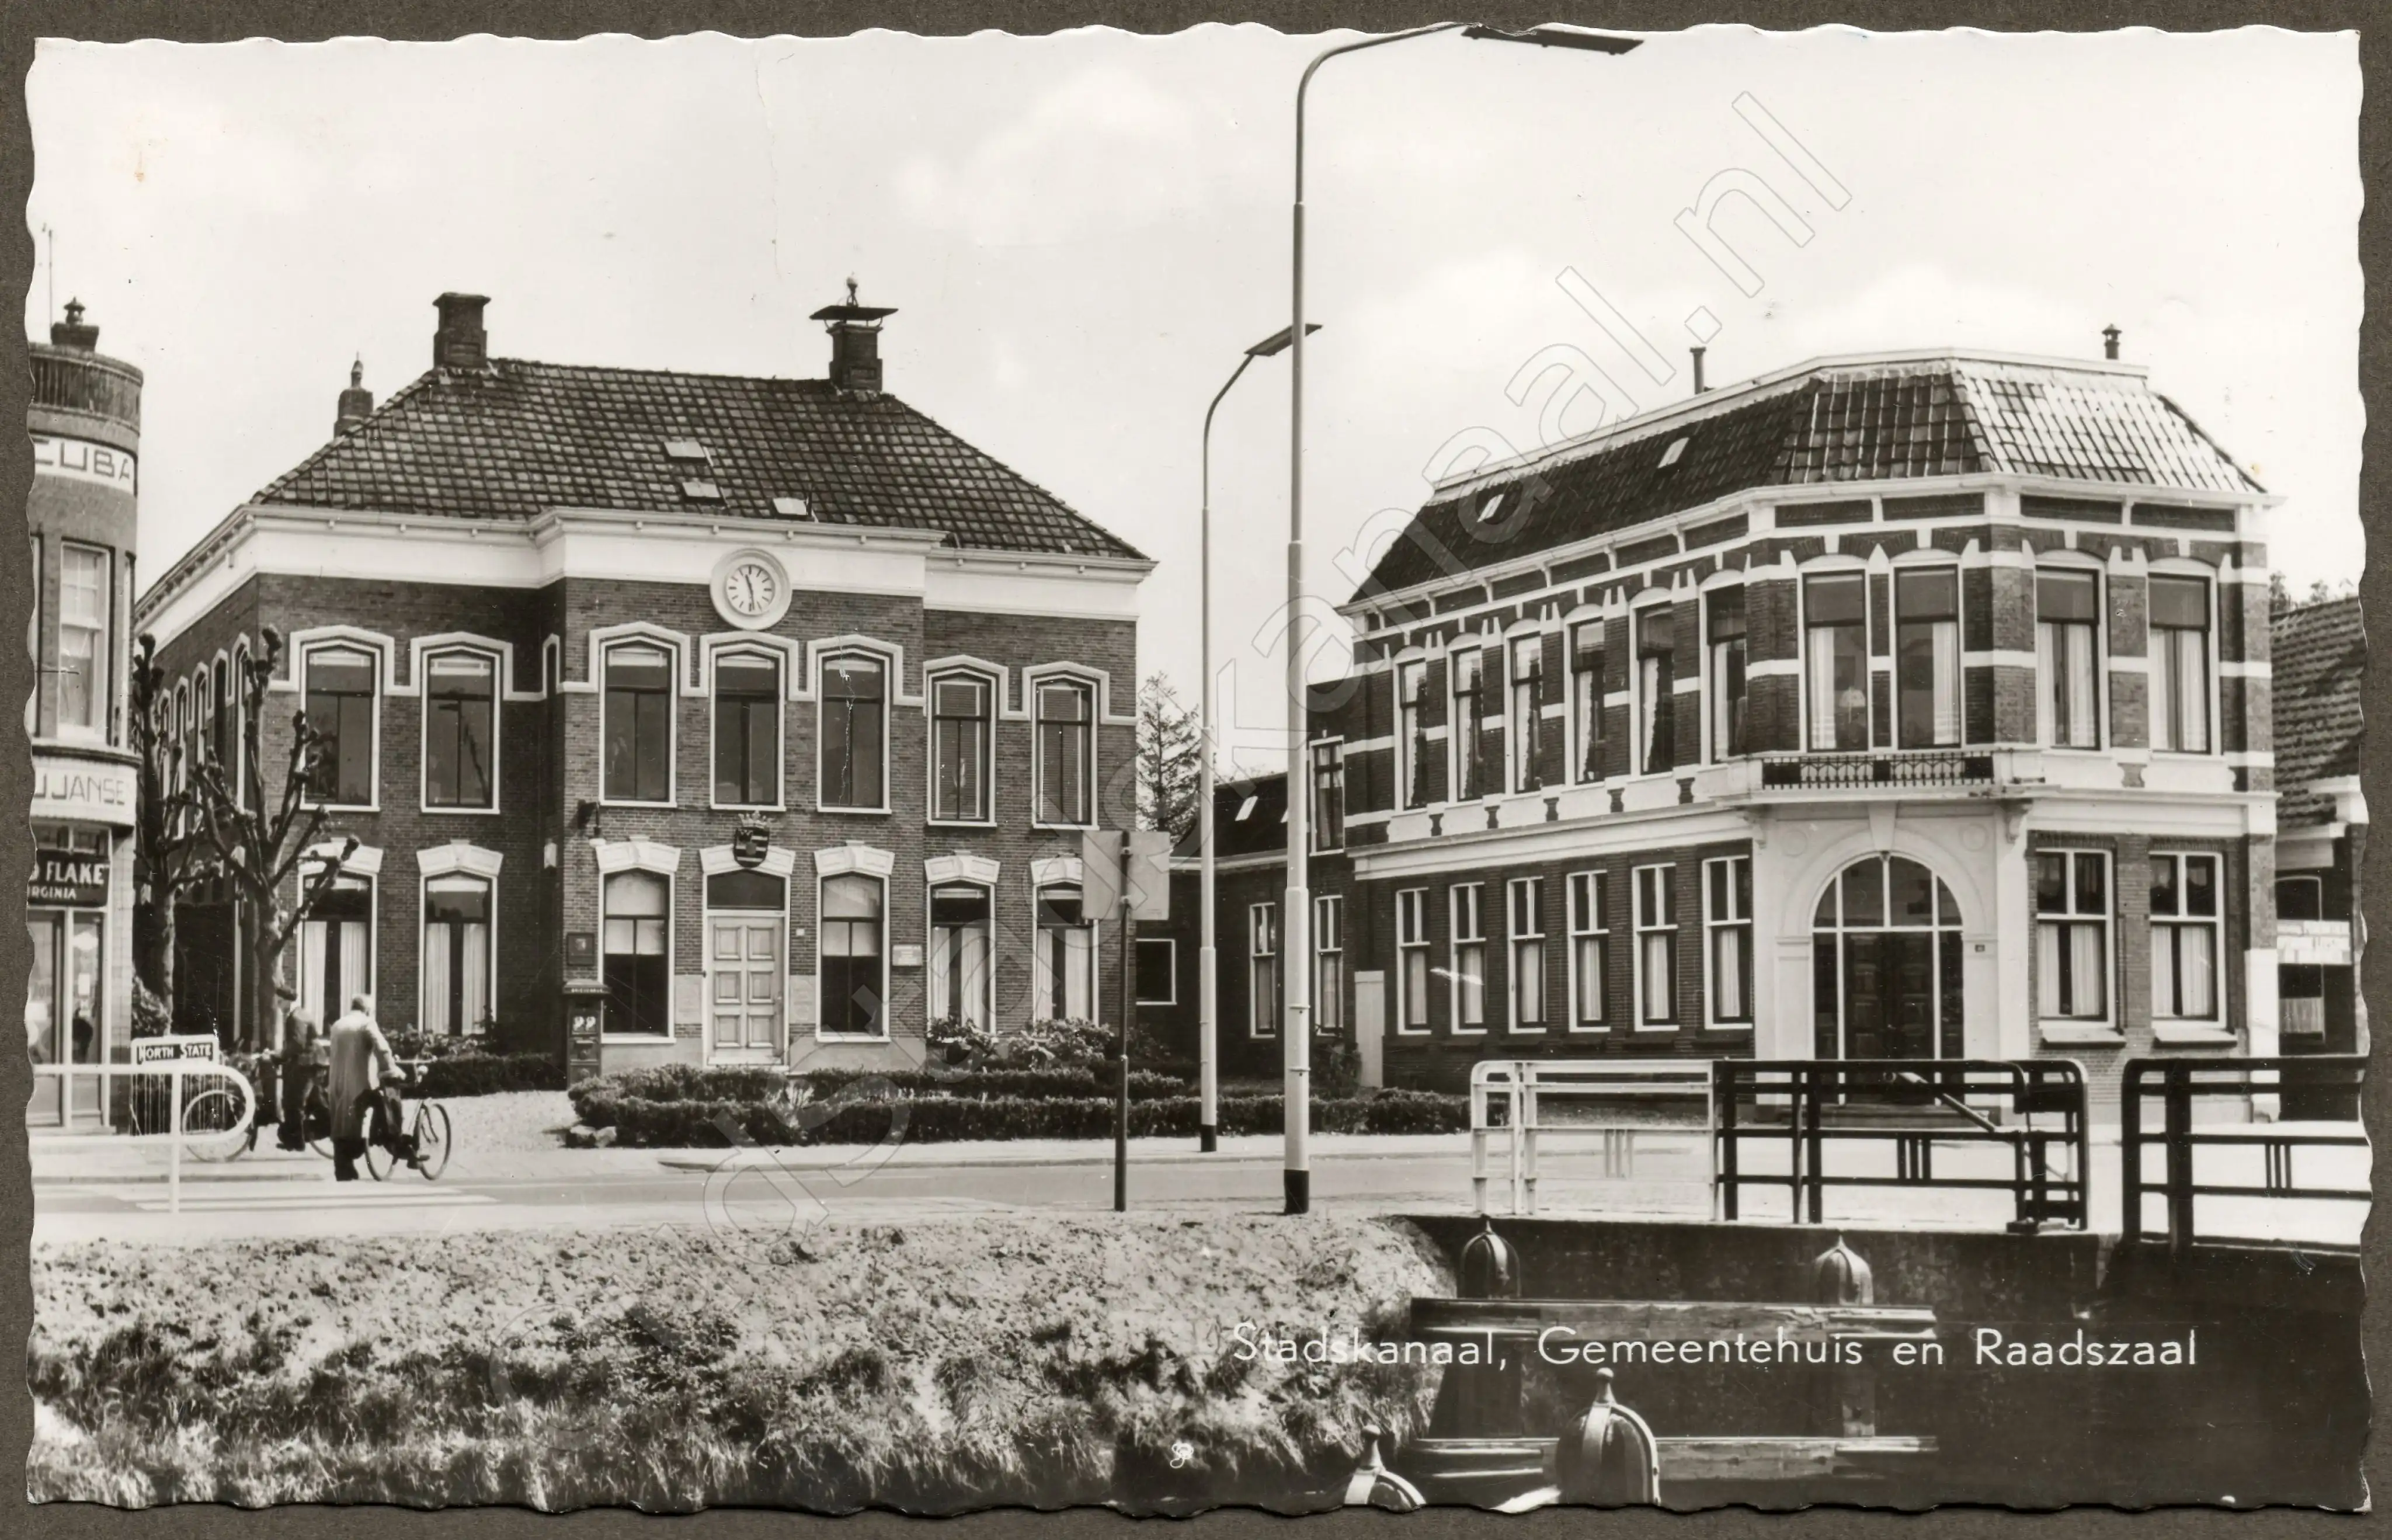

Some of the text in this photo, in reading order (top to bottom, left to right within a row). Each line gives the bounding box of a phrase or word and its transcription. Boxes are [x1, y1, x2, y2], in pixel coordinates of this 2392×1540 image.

[46, 861, 107, 885] FLAKE
[138, 1042, 211, 1063] NORTH STATE
